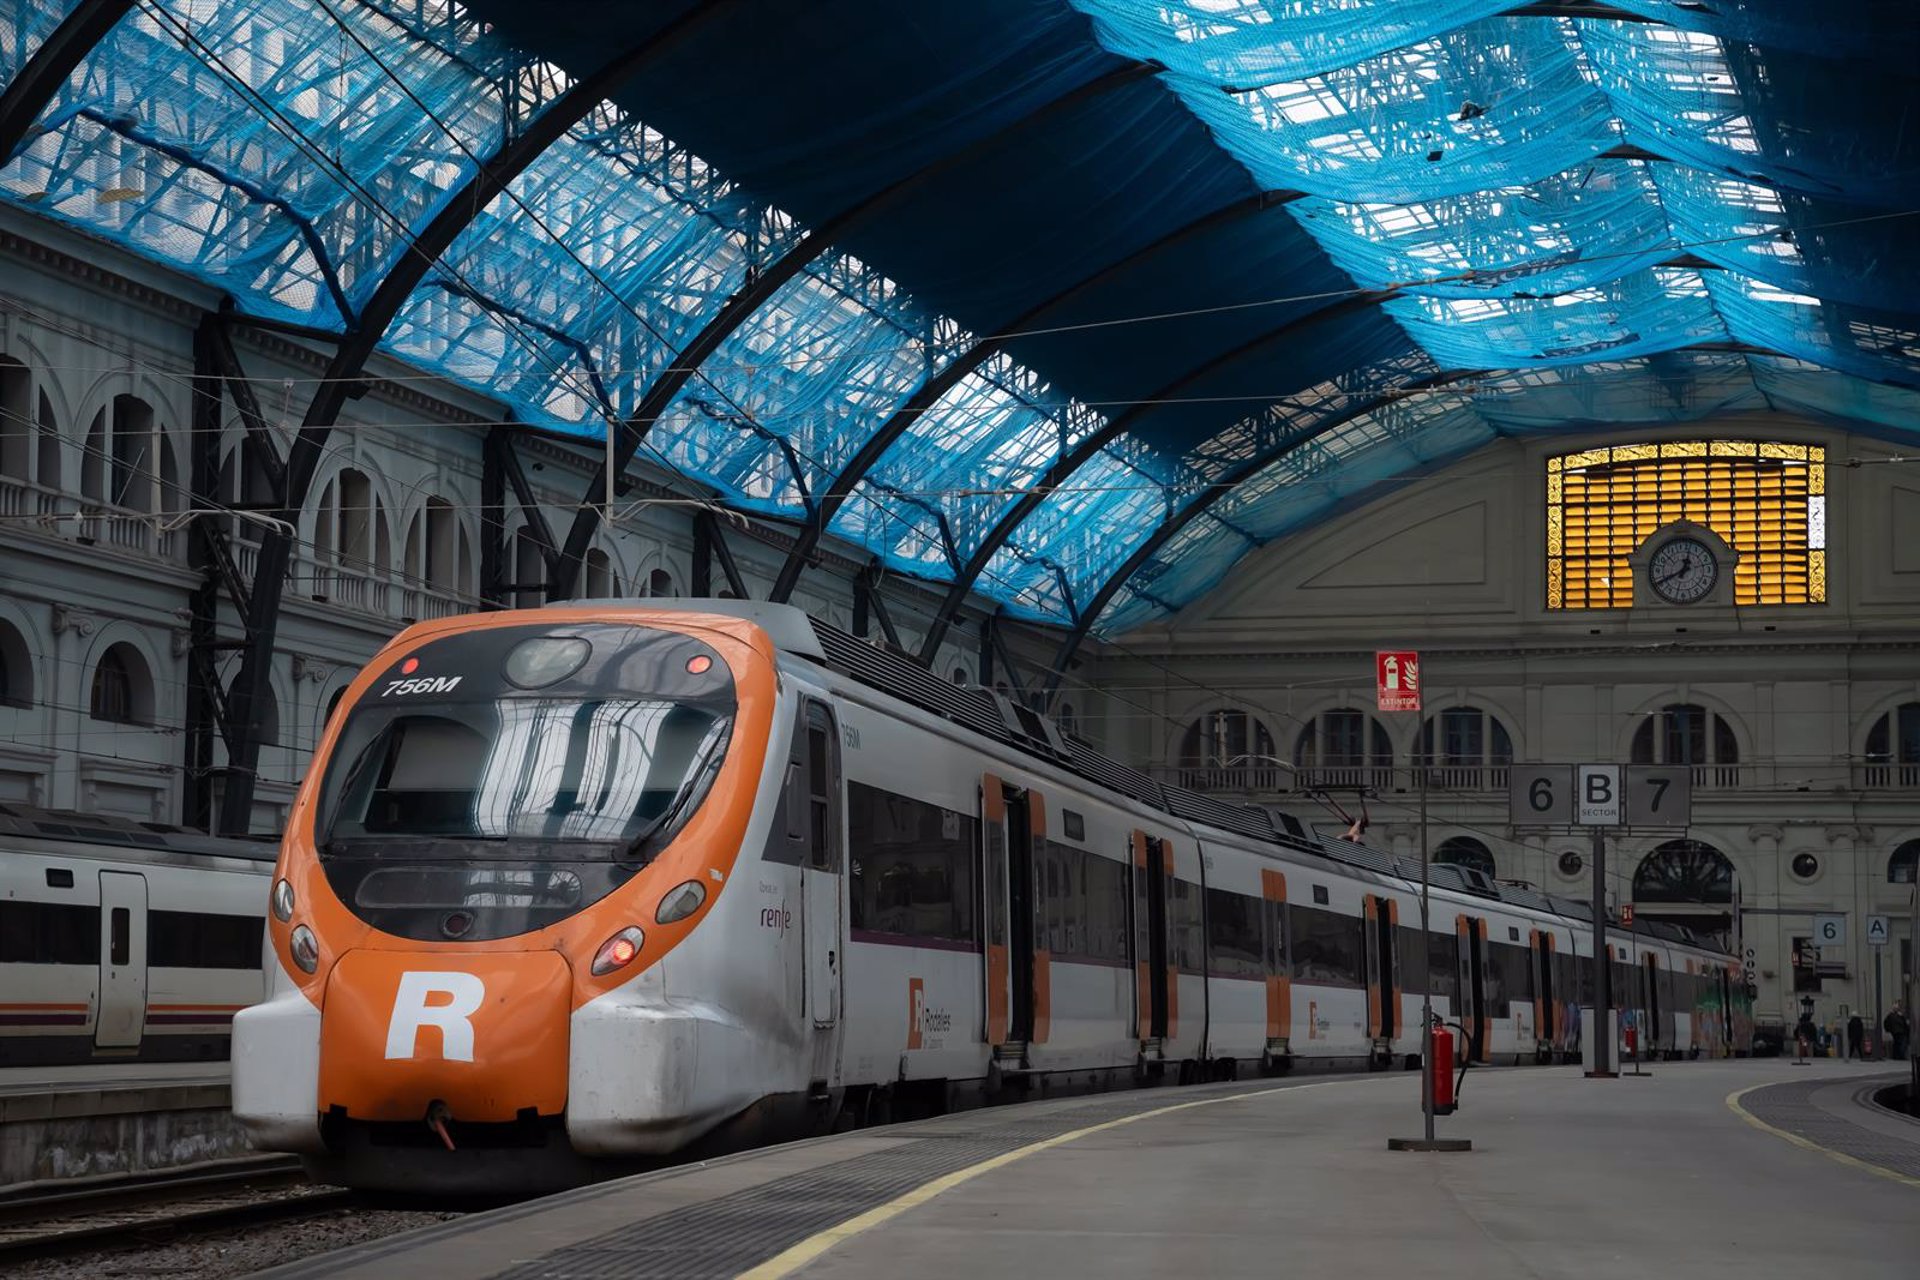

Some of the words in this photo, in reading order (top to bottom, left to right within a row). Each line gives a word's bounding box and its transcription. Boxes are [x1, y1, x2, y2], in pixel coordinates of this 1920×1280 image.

[381, 676, 463, 697] 756M
[841, 722, 862, 750] 756M
[1529, 778, 1553, 812] 6
[1587, 773, 1612, 804] B
[1646, 778, 1671, 813] 7
[1581, 808, 1617, 817] SECTOR
[760, 897, 791, 939] renfe
[1823, 922, 1836, 939] 6
[1870, 919, 1885, 935] A
[385, 970, 486, 1062] R
